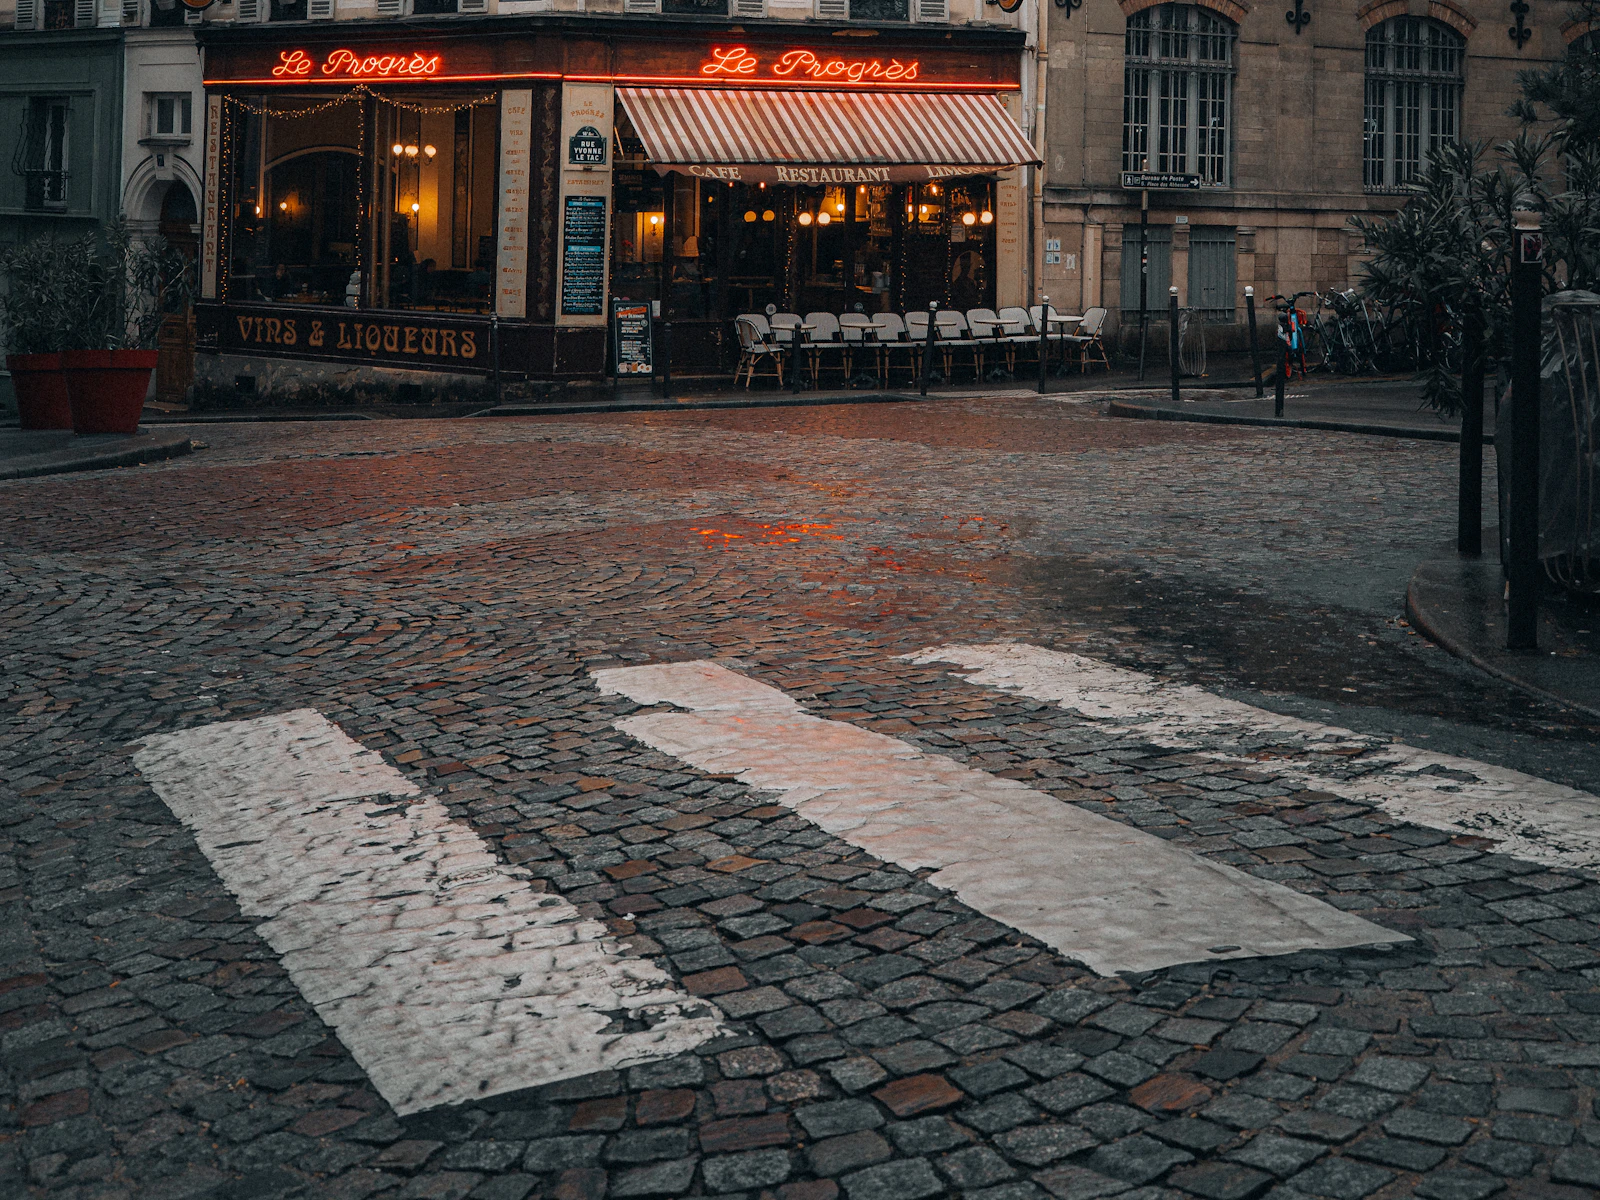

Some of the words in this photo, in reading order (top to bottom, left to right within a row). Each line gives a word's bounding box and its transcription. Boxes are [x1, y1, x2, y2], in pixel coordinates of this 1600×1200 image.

[272, 50, 311, 76] Le
[322, 49, 439, 76] Progrès
[702, 47, 757, 74] Le
[773, 50, 919, 82] Progrès
[574, 147, 602, 155] YVONNE
[580, 140, 596, 148] RUE
[774, 165, 891, 183] RESTAURANT
[205, 105, 219, 273] RESTAURANT
[236, 315, 298, 345] VINS
[308, 320, 325, 347] &
[336, 322, 477, 359] LIQUEURS
